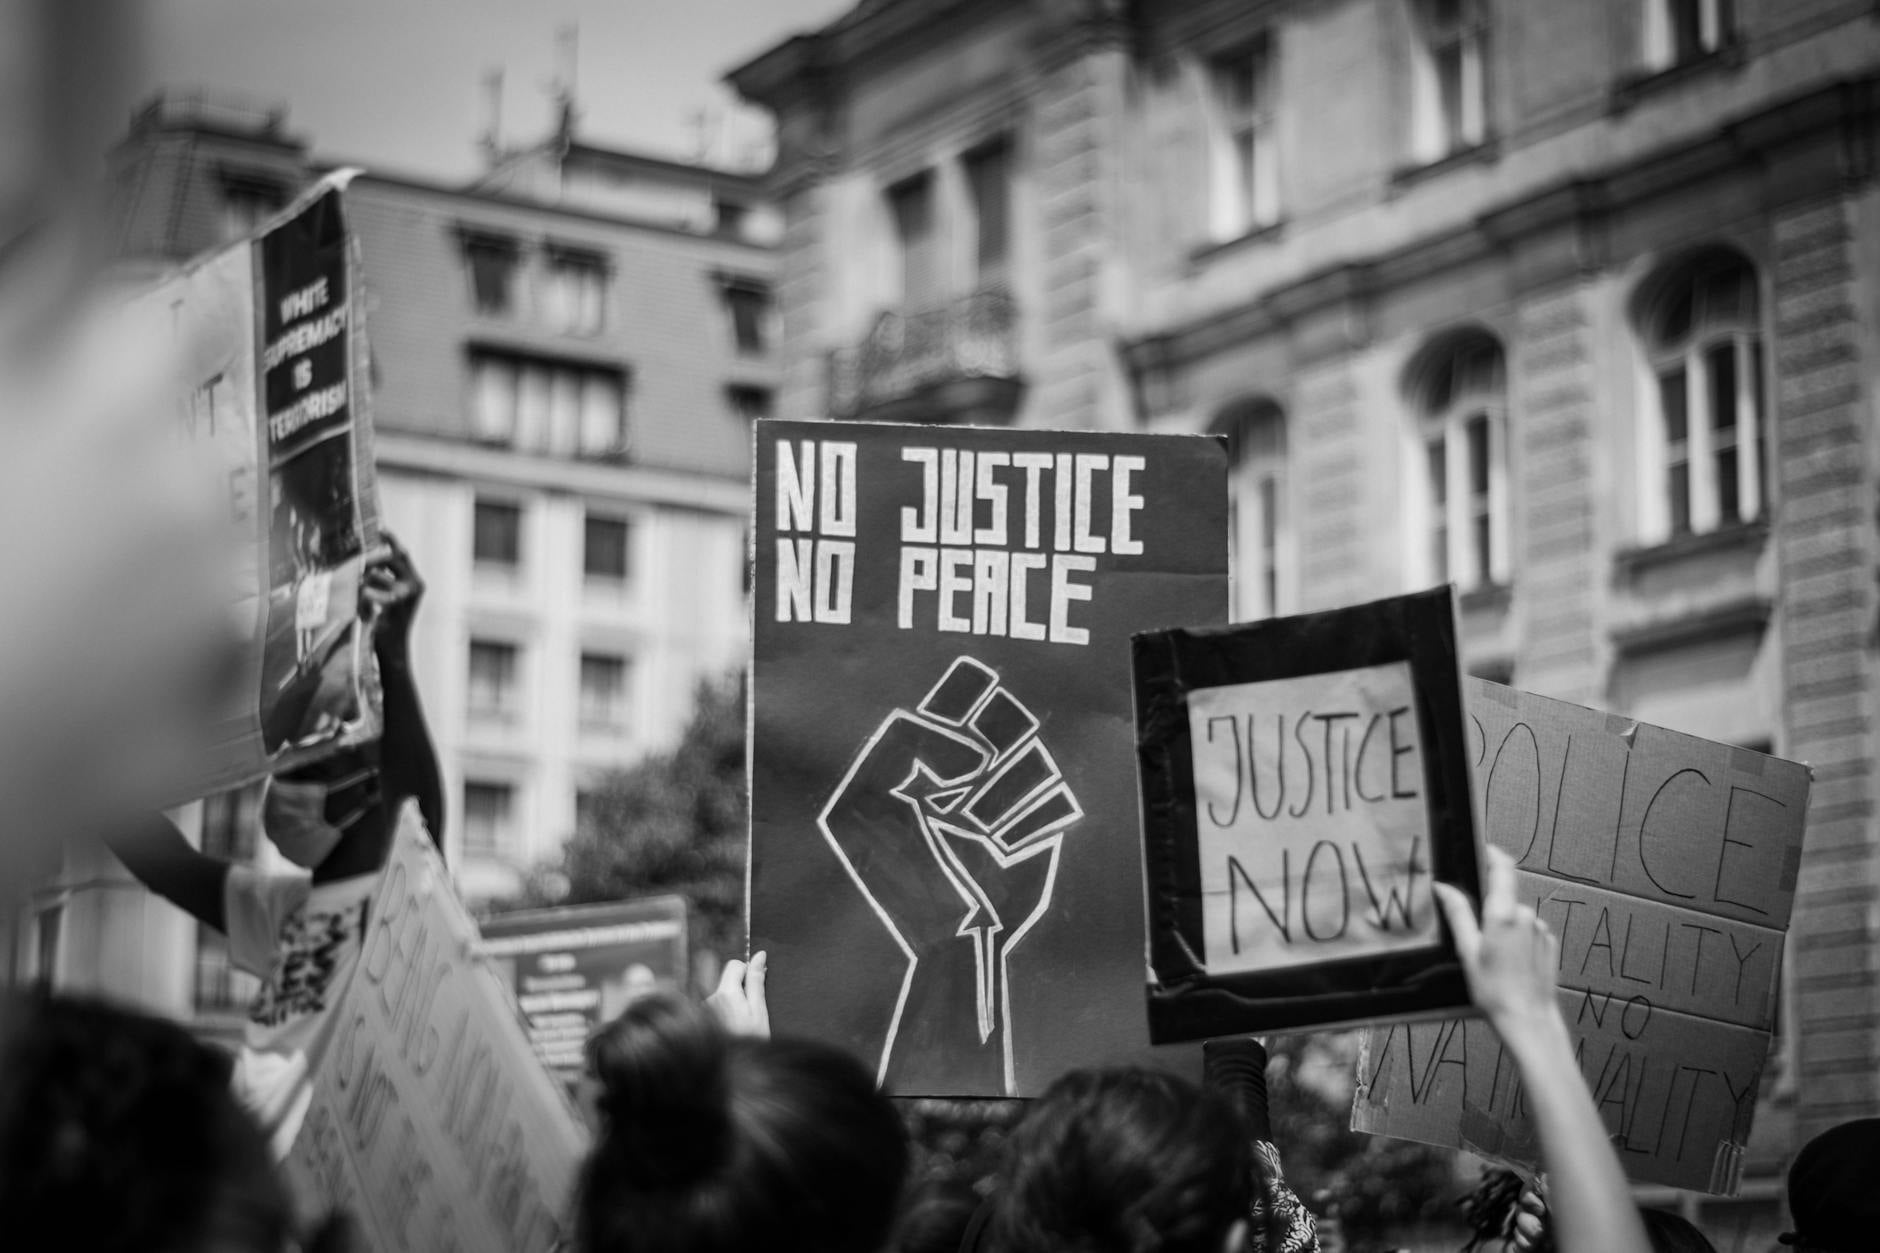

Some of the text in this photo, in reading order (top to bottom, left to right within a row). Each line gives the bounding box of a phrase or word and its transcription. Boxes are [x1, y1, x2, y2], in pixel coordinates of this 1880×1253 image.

[280, 275, 331, 325] WHITE
[293, 356, 313, 393] IS
[775, 439, 1146, 555] NO JUSTICE
[775, 537, 1097, 645] NO PEACE
[1207, 706, 1418, 828] JUSTICE
[1227, 835, 1424, 955] NOW
[1536, 896, 1762, 1006] TALITY
[1577, 986, 1652, 1040] NO
